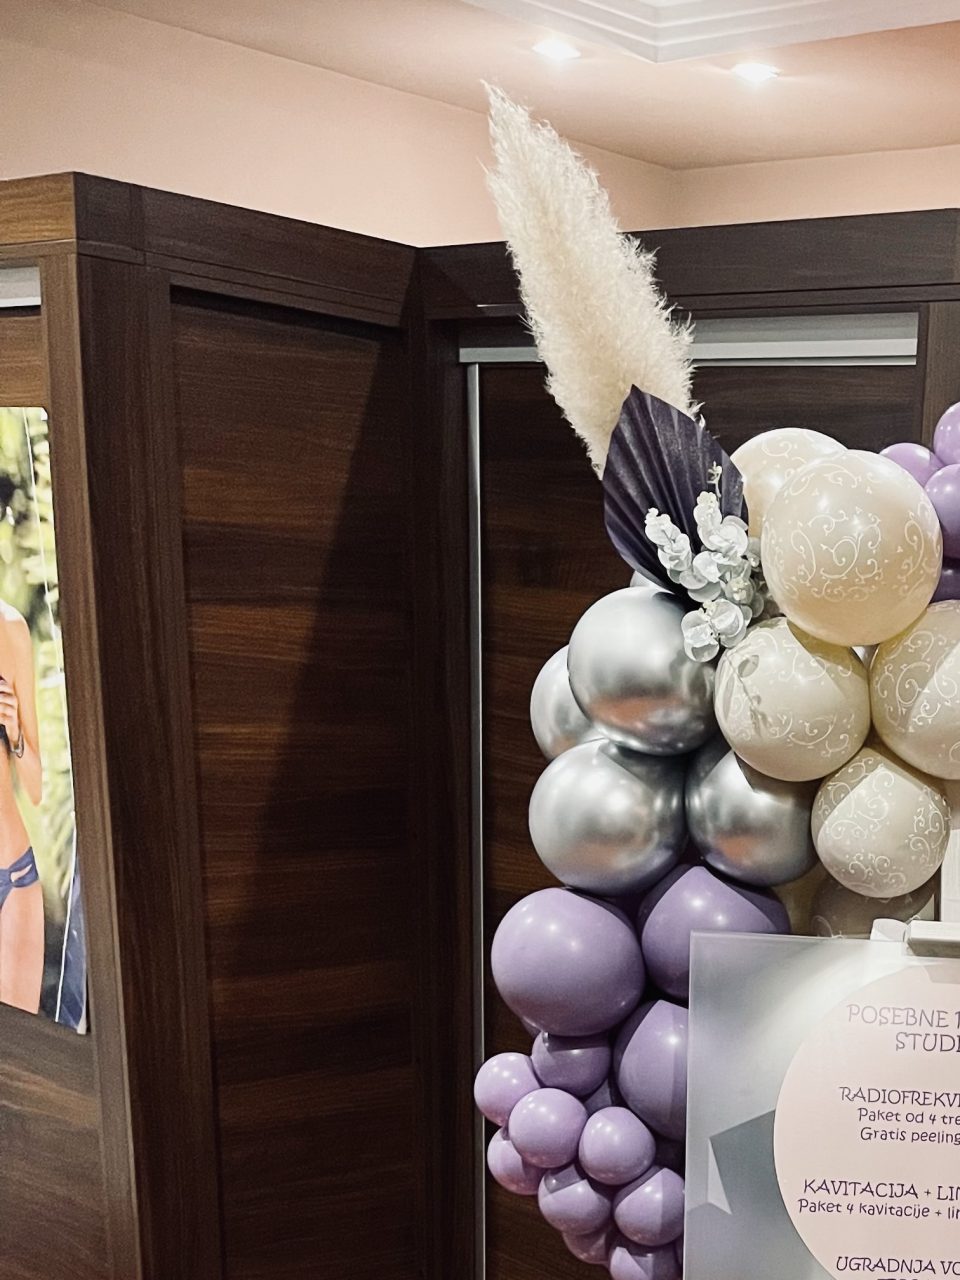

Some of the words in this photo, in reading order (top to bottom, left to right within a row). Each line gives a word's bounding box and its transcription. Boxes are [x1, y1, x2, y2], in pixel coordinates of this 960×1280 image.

[847, 1004, 948, 1028] POSEBNE
[858, 1107, 901, 1123] Paket
[905, 1110, 924, 1124] od
[929, 1113, 936, 1124] 4
[860, 1127, 906, 1142] Gratis
[804, 1179, 919, 1199] KAVITACIJA
[798, 1198, 842, 1214] Paket
[847, 1203, 854, 1214] 4
[859, 1203, 930, 1219] kavitacije
[836, 1256, 936, 1275] UGRADNJA
